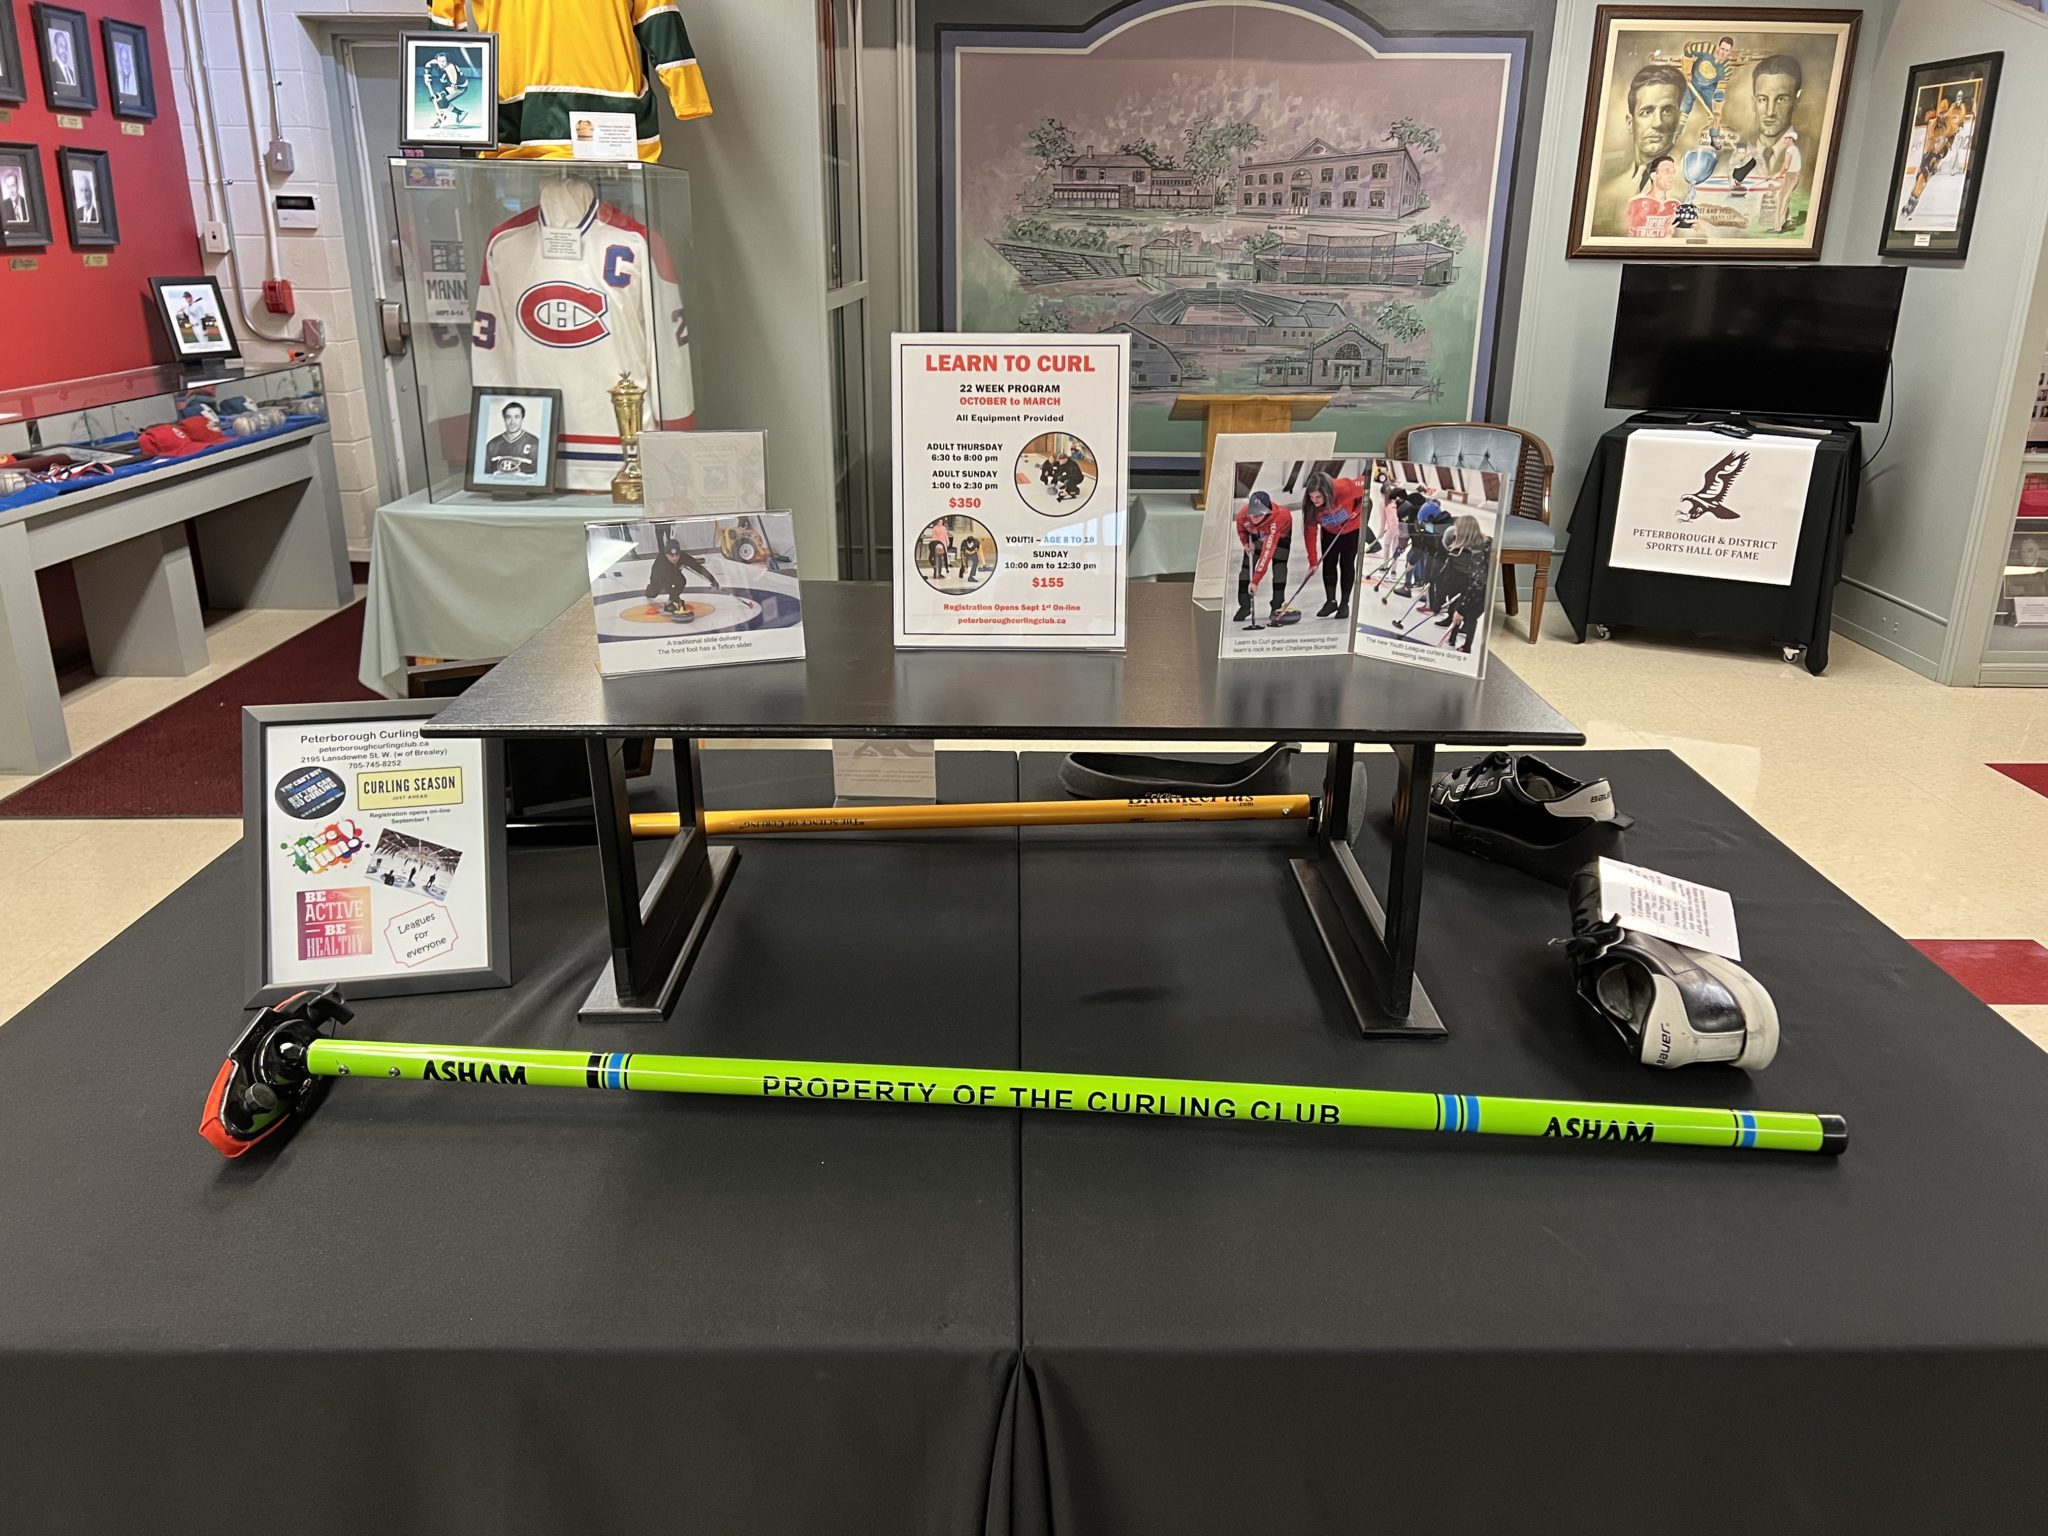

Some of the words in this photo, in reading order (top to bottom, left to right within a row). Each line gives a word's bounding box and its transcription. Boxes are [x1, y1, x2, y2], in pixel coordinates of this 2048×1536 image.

[603, 244, 635, 289] C
[472, 310, 496, 350] 3
[926, 355, 998, 372] LEARN
[1004, 355, 1030, 372] TO
[1037, 355, 1095, 372] CURL
[959, 384, 973, 393] 22
[975, 384, 1004, 393] WEEK
[1008, 384, 1060, 393] PROGRAM
[959, 397, 1007, 406] OCTOBER
[1010, 397, 1020, 405] to
[1023, 397, 1060, 405] MARCH
[956, 414, 968, 422] All
[971, 414, 1020, 424] Equipment
[1023, 414, 1064, 422] Provided
[927, 443, 955, 451] ADULT
[957, 443, 1003, 451] THURSDAY
[931, 454, 950, 462] 6:30
[964, 454, 982, 462] 8:00
[949, 497, 981, 509] $350
[1005, 536, 1034, 544] YOUTH
[1043, 536, 1061, 544] AGE
[1063, 536, 1068, 544] 8
[1070, 536, 1082, 544] TO
[1084, 536, 1094, 544] 18
[1633, 528, 1715, 544] PETERBOROUGH
[1729, 538, 1778, 549] DISTRICT
[1033, 550, 1068, 558] SUNDAY
[1646, 542, 1684, 552] SPORTS
[1686, 546, 1712, 555] HALL
[1715, 549, 1729, 557] OF
[1731, 551, 1759, 560] FAME
[1032, 577, 1064, 588] $155
[943, 604, 992, 613] Registration
[994, 604, 1019, 612] Opens
[1021, 604, 1039, 612] Sept
[958, 616, 1066, 625] peterboroughcurlingclub.ca
[301, 733, 376, 743] Peterborough
[380, 730, 419, 739] Curling
[319, 741, 429, 753] peterboroughcurlingclub.ca
[301, 754, 320, 763] 2195
[322, 753, 367, 761] Lansdowne
[349, 760, 401, 769] 705-745-8252
[364, 779, 409, 794] CURLING
[414, 776, 455, 791] SEASON
[305, 891, 326, 903] BE
[305, 900, 364, 921] ACTIVE
[398, 913, 435, 934] Leagues
[325, 924, 346, 936] BE
[307, 934, 363, 957] HEALTHY
[407, 937, 446, 958] everyone
[423, 1060, 527, 1085] ASHAM
[763, 1075, 937, 1103] PROPERTY
[952, 1084, 996, 1106] OF
[1009, 1087, 1074, 1110] THE
[1087, 1091, 1237, 1120] CURLING
[1251, 1100, 1341, 1125] CLUB
[1541, 1116, 1655, 1143] ASHAM
